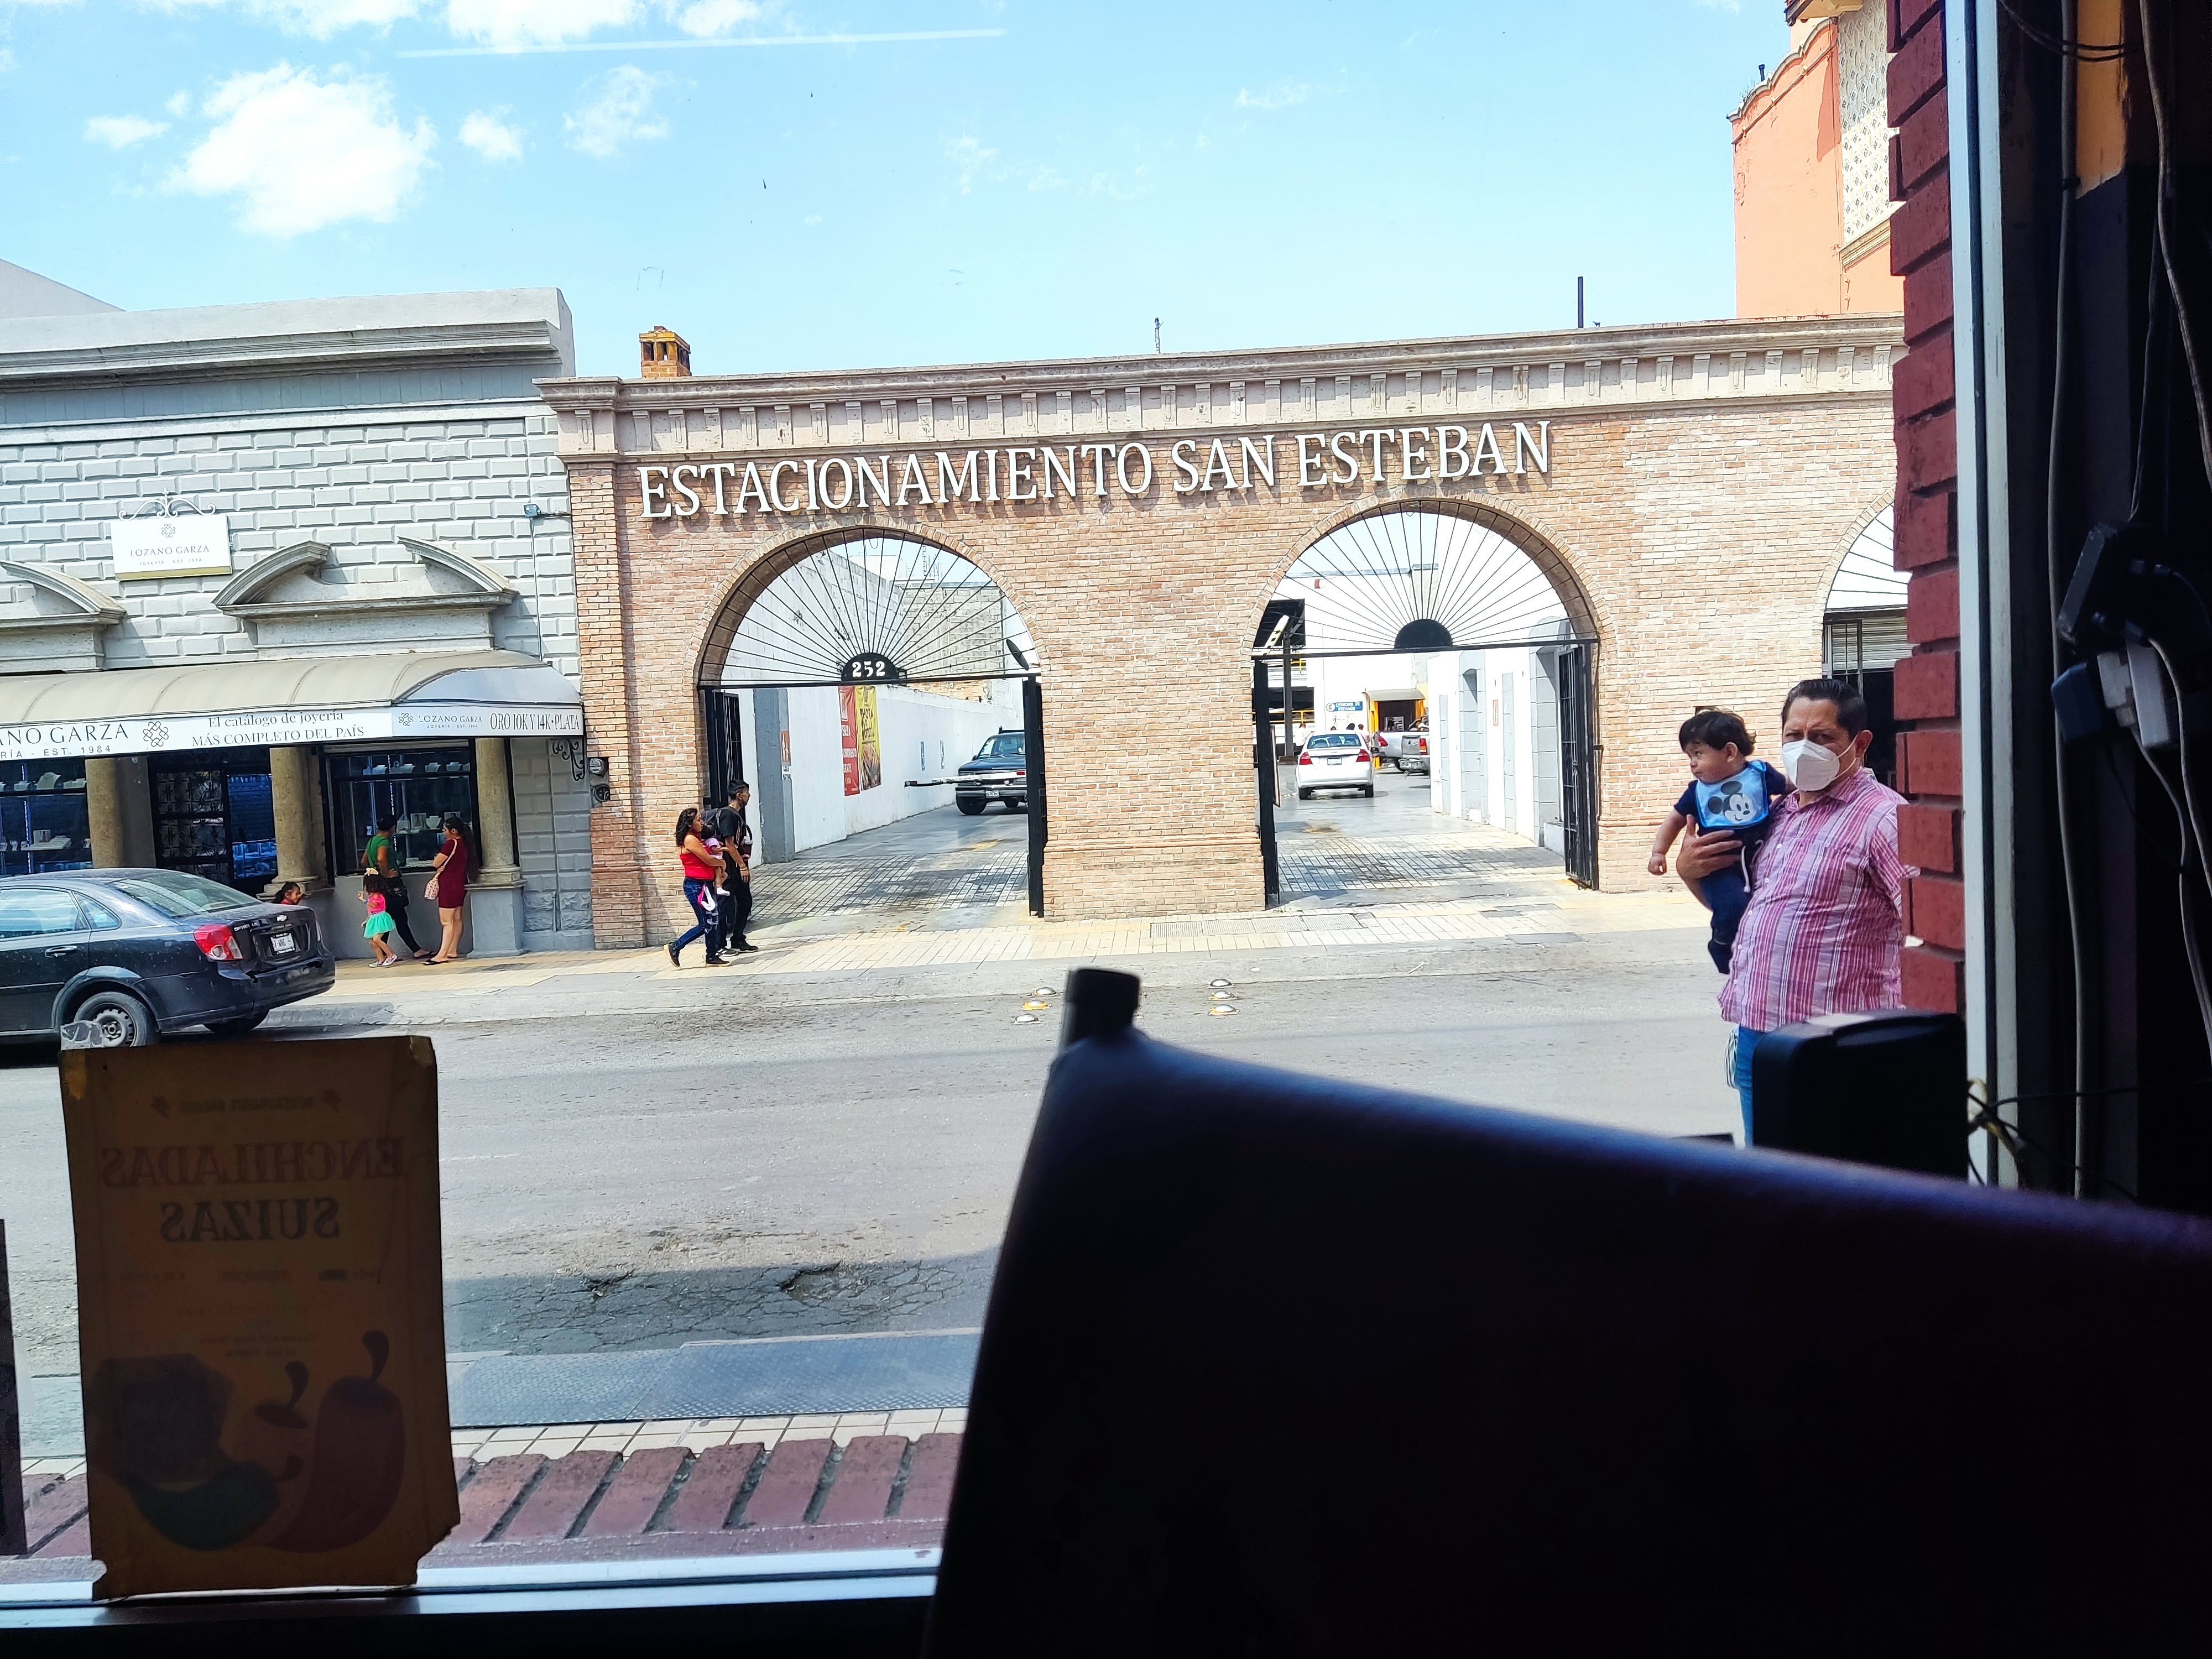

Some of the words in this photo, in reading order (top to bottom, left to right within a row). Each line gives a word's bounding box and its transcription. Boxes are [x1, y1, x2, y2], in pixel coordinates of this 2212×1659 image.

[636, 442, 1152, 519] ESTACIONAMIENTO
[1172, 434, 1276, 493] SAN
[1295, 420, 1551, 487] ESTEBAN
[131, 547, 173, 557] LOZANO
[176, 545, 210, 554] GARZA
[852, 661, 885, 677] 252
[209, 717, 220, 728] El
[225, 714, 277, 727] catálogo
[281, 712, 296, 724] de
[490, 713, 510, 731] ORO
[513, 713, 529, 731] 10K
[530, 714, 535, 730] Y
[0, 728, 41, 746] NO
[50, 723, 128, 743] GARZA
[192, 733, 220, 747] MÁS
[224, 730, 300, 744] COMPLETO
[304, 728, 332, 739] DEL
[336, 724, 364, 738] PAÍS
[81, 745, 111, 754] 1984
